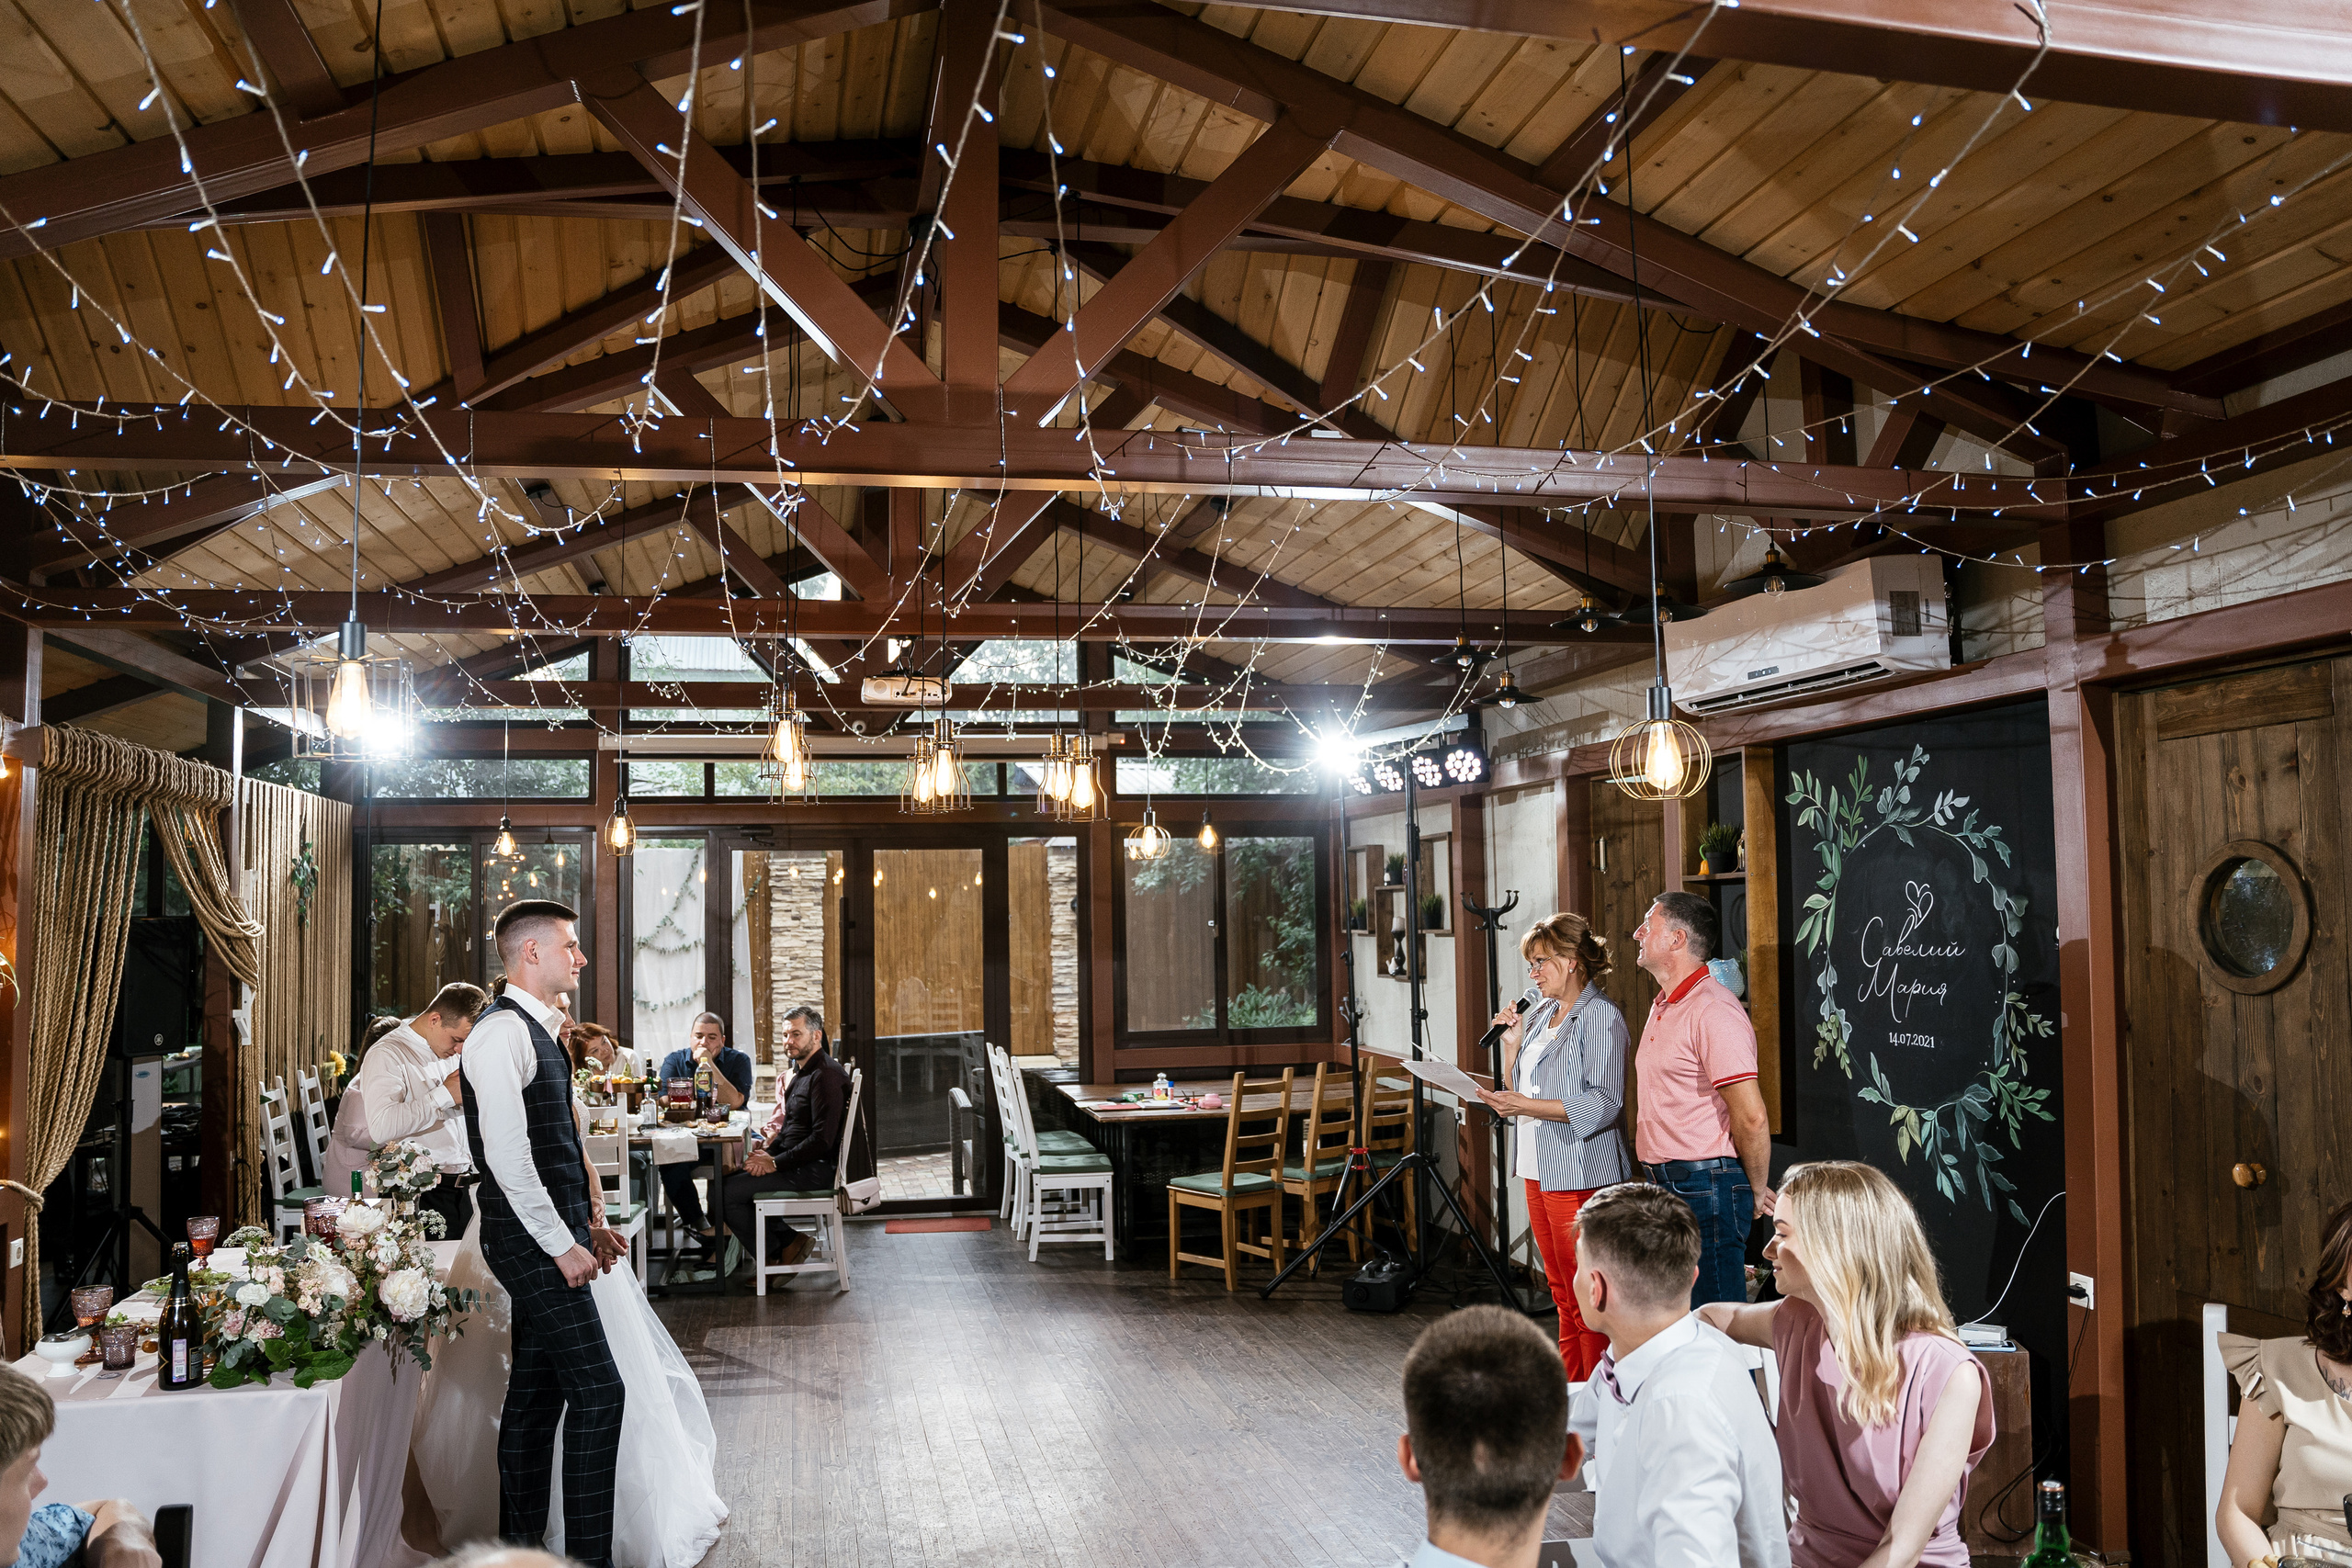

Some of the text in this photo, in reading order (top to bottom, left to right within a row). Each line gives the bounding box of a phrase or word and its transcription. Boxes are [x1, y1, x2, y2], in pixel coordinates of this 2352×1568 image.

[1860, 909, 1966, 968] Савелий
[1858, 957, 1948, 1023] Мария
[1888, 1032, 1935, 1049] 14.07.2021
